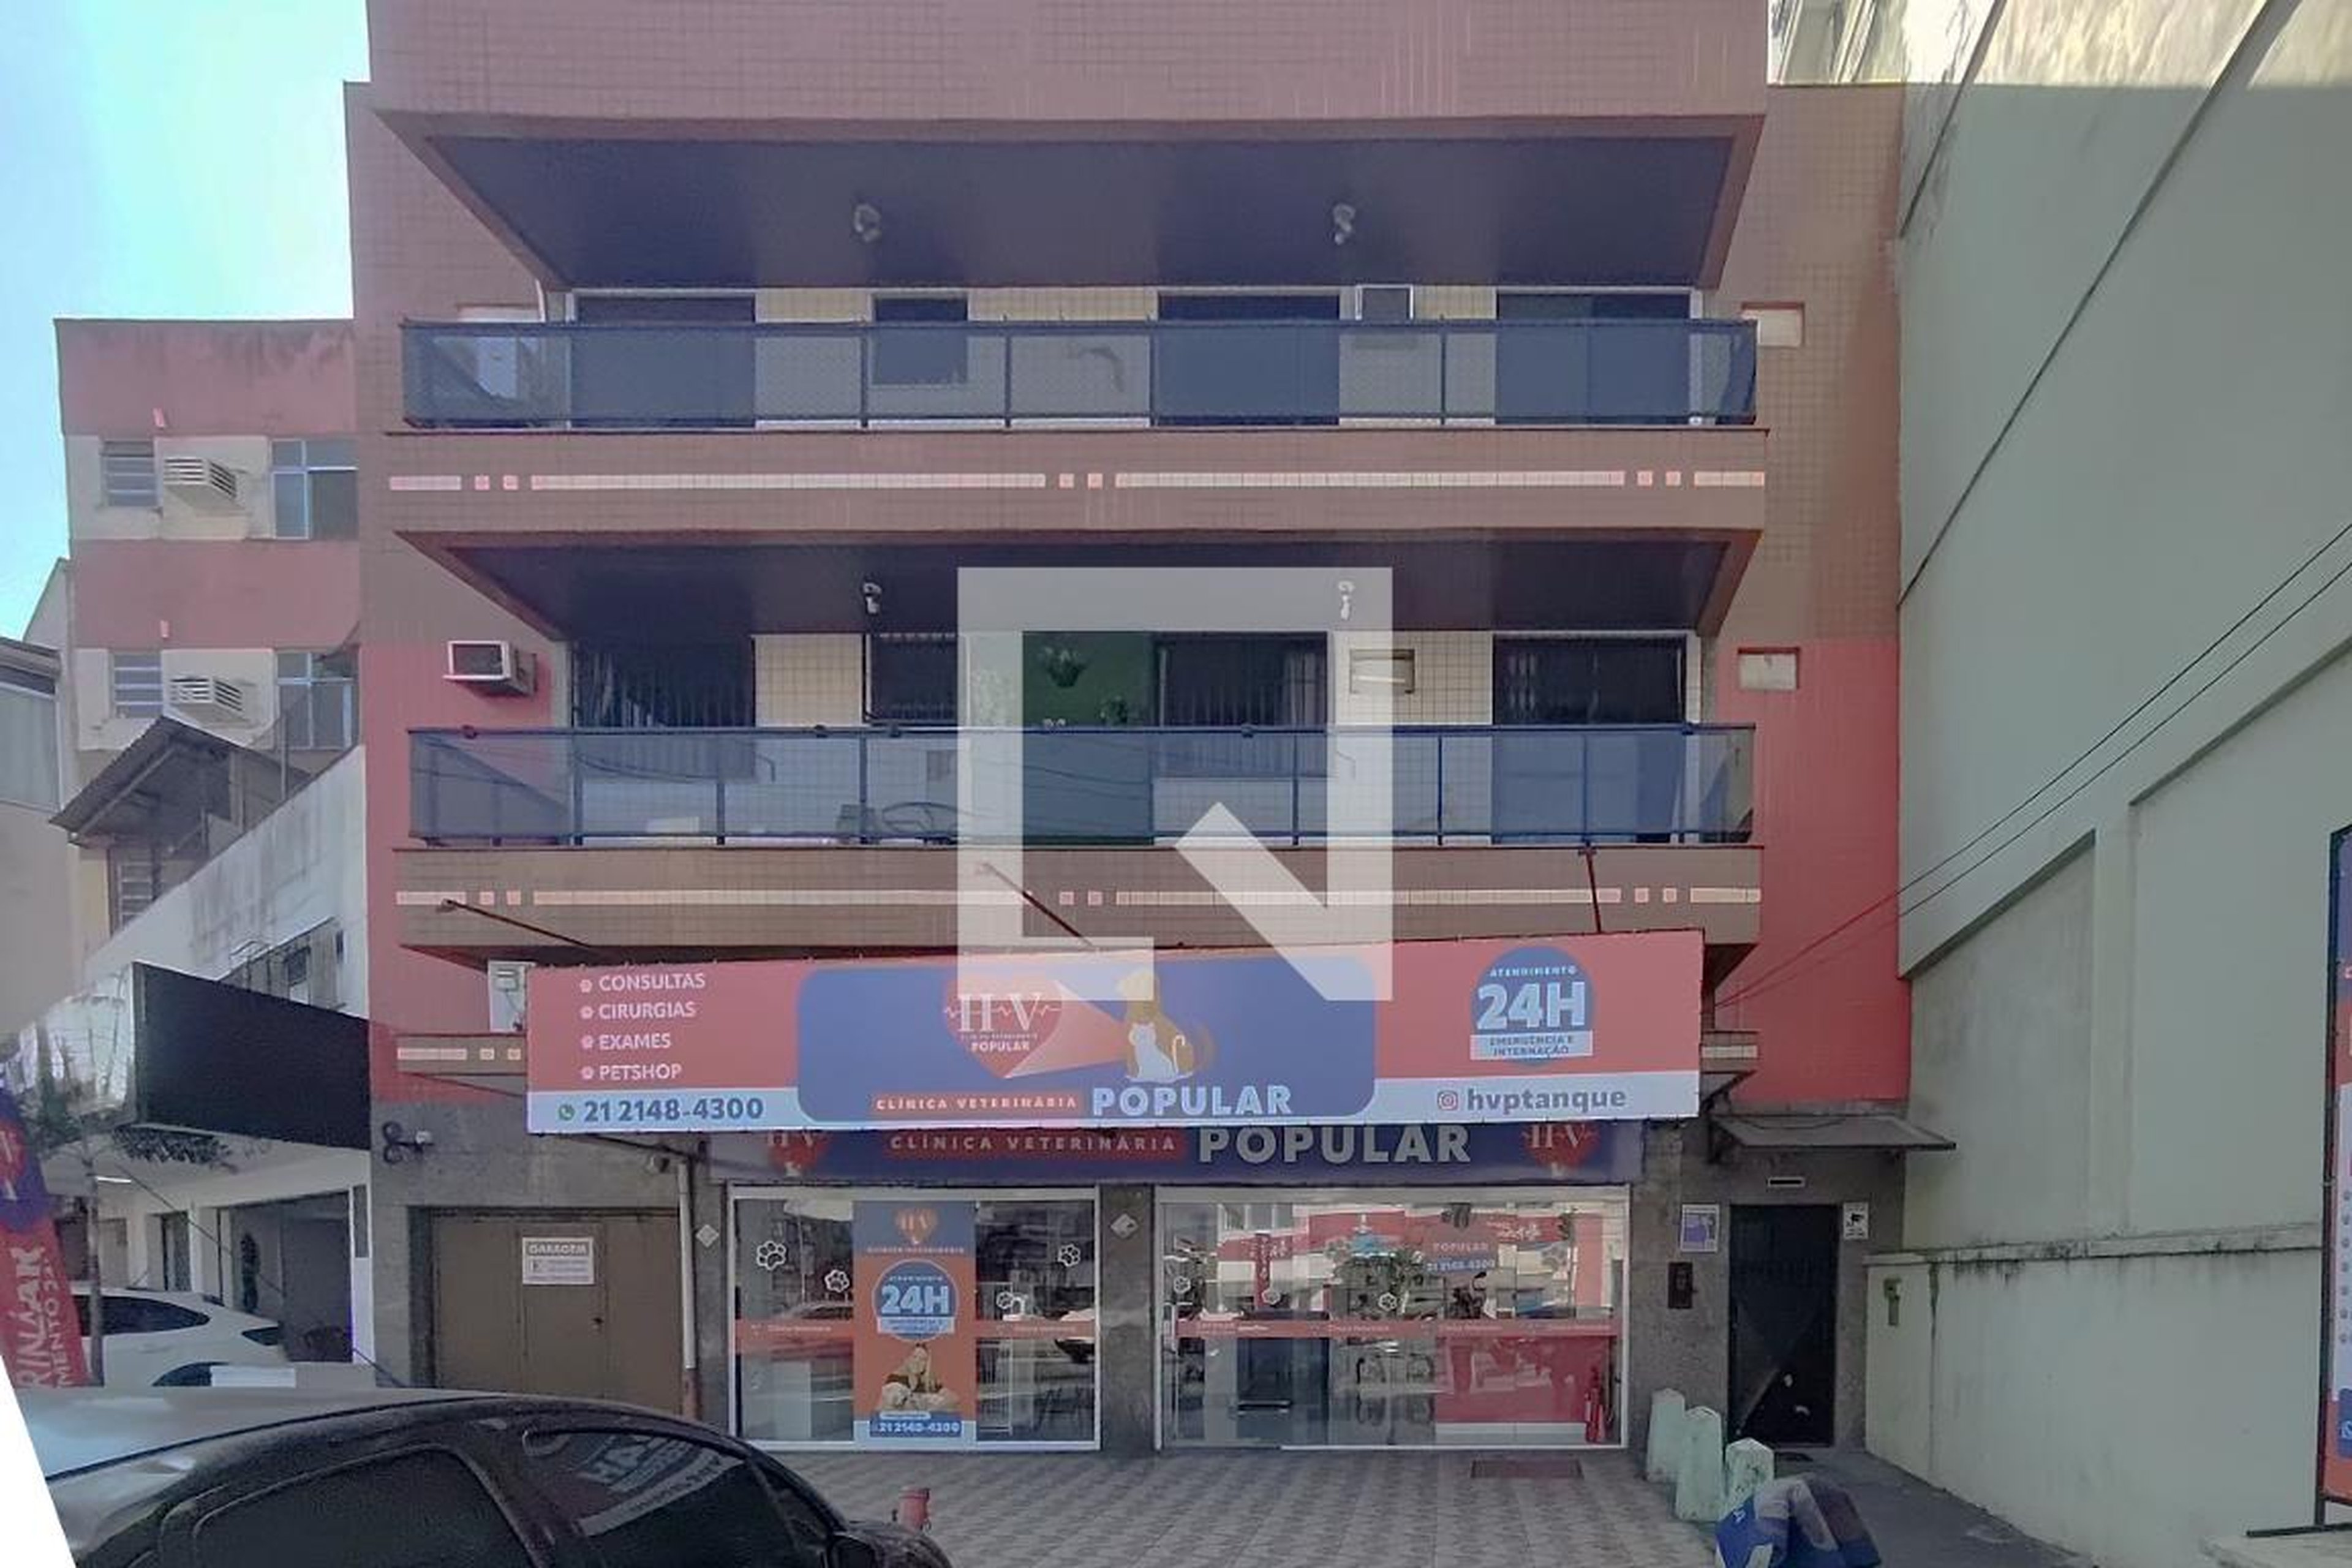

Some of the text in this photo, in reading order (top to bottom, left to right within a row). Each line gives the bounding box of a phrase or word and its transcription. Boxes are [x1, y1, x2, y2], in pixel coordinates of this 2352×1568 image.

[599, 973, 706, 991] CONSULTAS
[598, 1001, 696, 1019] CIRURGIAS
[1477, 981, 1585, 1029] 24H
[598, 1033, 671, 1050] EXAMES
[971, 1041, 1030, 1052] POPULAR
[599, 1063, 682, 1080] PETSHOP
[584, 1101, 611, 1121] 21
[876, 1097, 948, 1110] CLÍNICA
[1093, 1085, 1292, 1117] POPULAR
[1468, 1089, 1626, 1115] hvptanque
[1199, 1125, 1470, 1164] POPULAR
[881, 1285, 949, 1314] 24H
